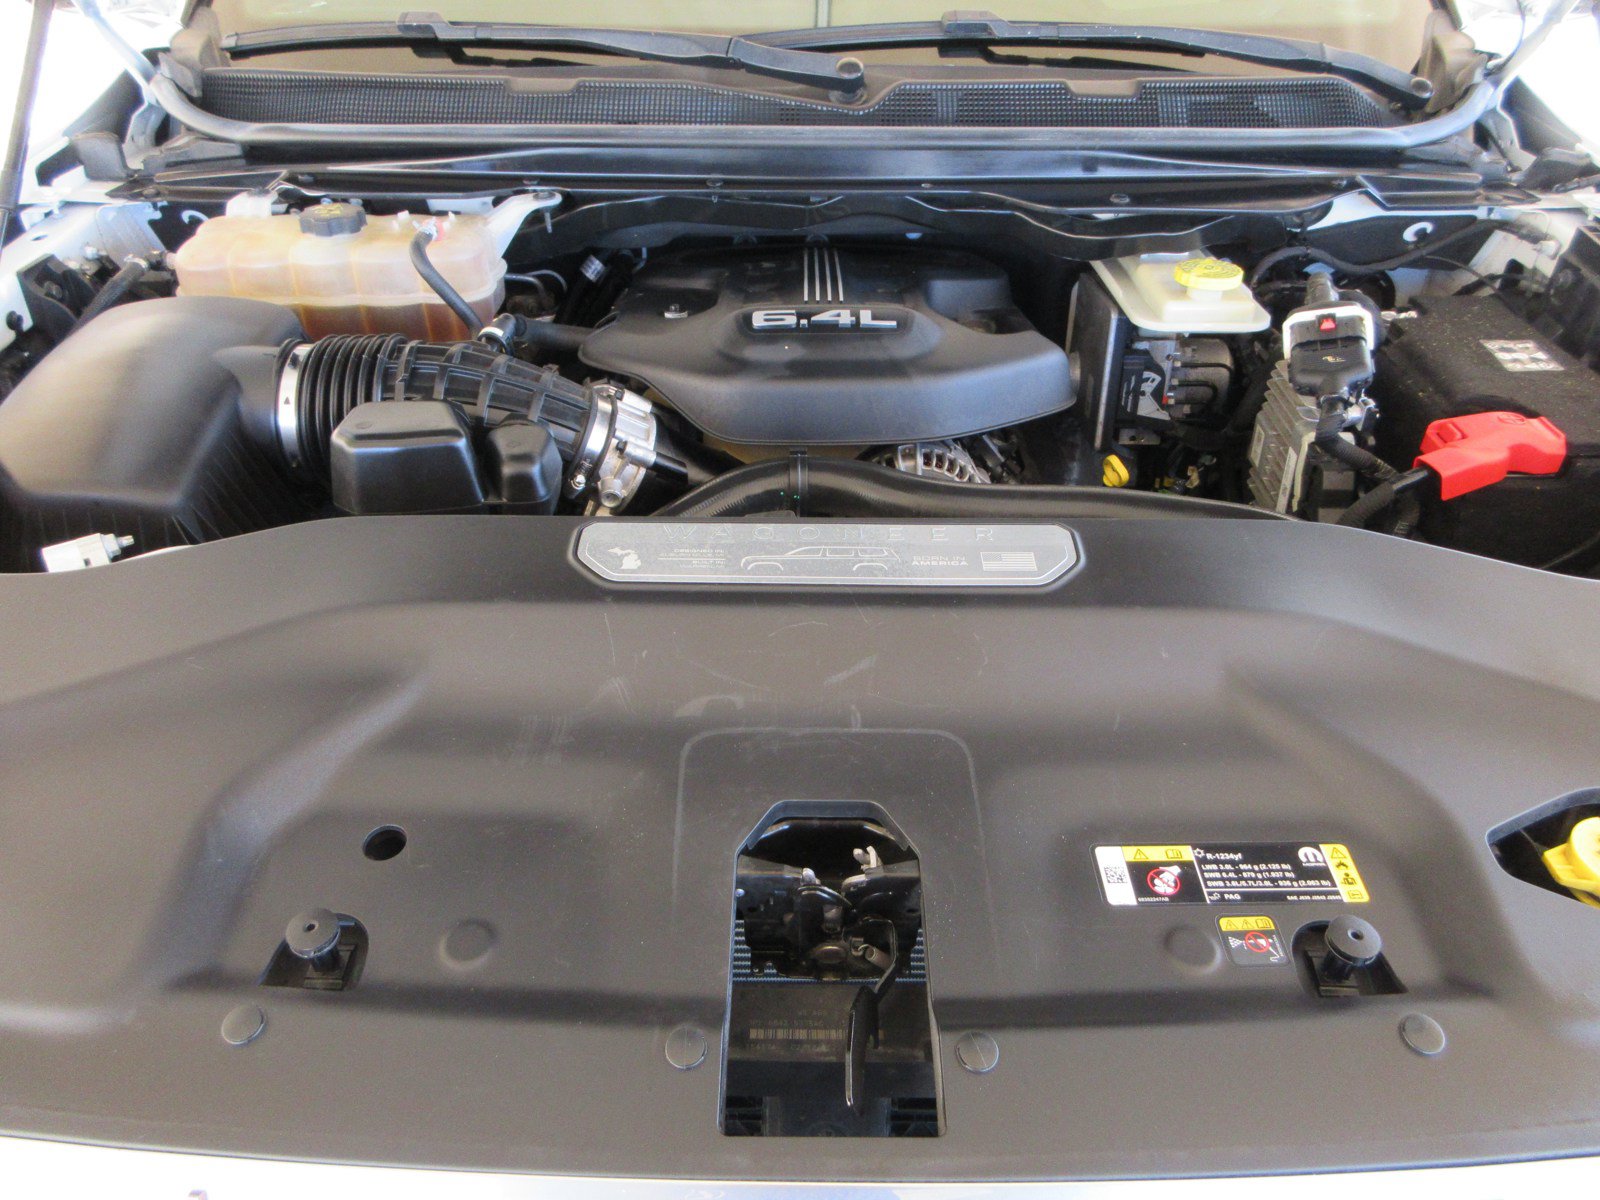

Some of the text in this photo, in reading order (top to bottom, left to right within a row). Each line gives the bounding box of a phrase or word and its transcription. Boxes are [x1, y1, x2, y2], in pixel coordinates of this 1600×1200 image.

[752, 309, 897, 329] 6.4L
[663, 525, 994, 541] WAGONEER
[1206, 852, 1243, 861] R-1234yf
